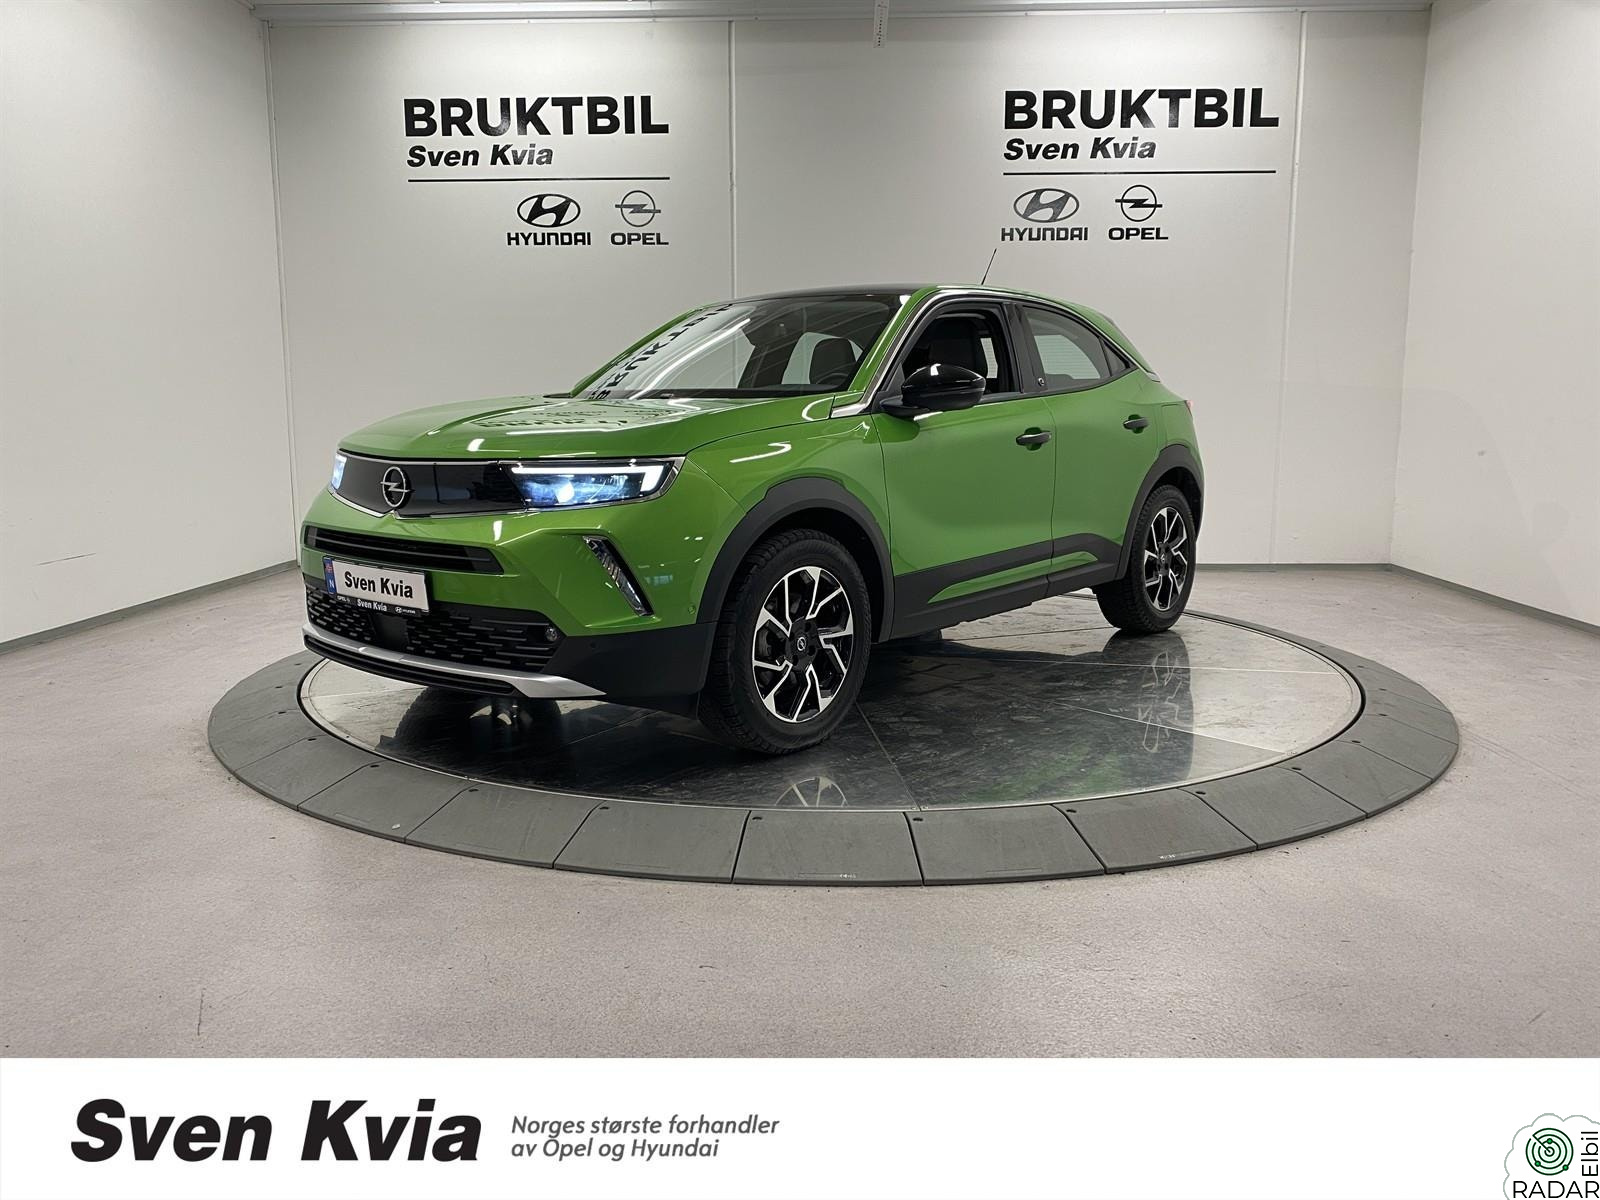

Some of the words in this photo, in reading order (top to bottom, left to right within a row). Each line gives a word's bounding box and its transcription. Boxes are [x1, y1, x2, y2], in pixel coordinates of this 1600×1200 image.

[403, 95, 670, 137] BRUKTBIL
[1003, 87, 1280, 130] BRUKTBIL
[406, 145, 480, 168] Sven
[489, 143, 554, 166] Kvia
[1003, 137, 1080, 161] Sven
[1089, 136, 1158, 159] Kvia
[506, 231, 592, 246] HYUNDAI
[610, 232, 670, 246] OPEL
[1000, 226, 1089, 242] HYUNDAI
[1107, 227, 1169, 241] OPEL
[344, 571, 376, 592] Sven
[380, 577, 413, 598] Kvia
[357, 598, 373, 609] Sven
[372, 602, 388, 612] Kvia
